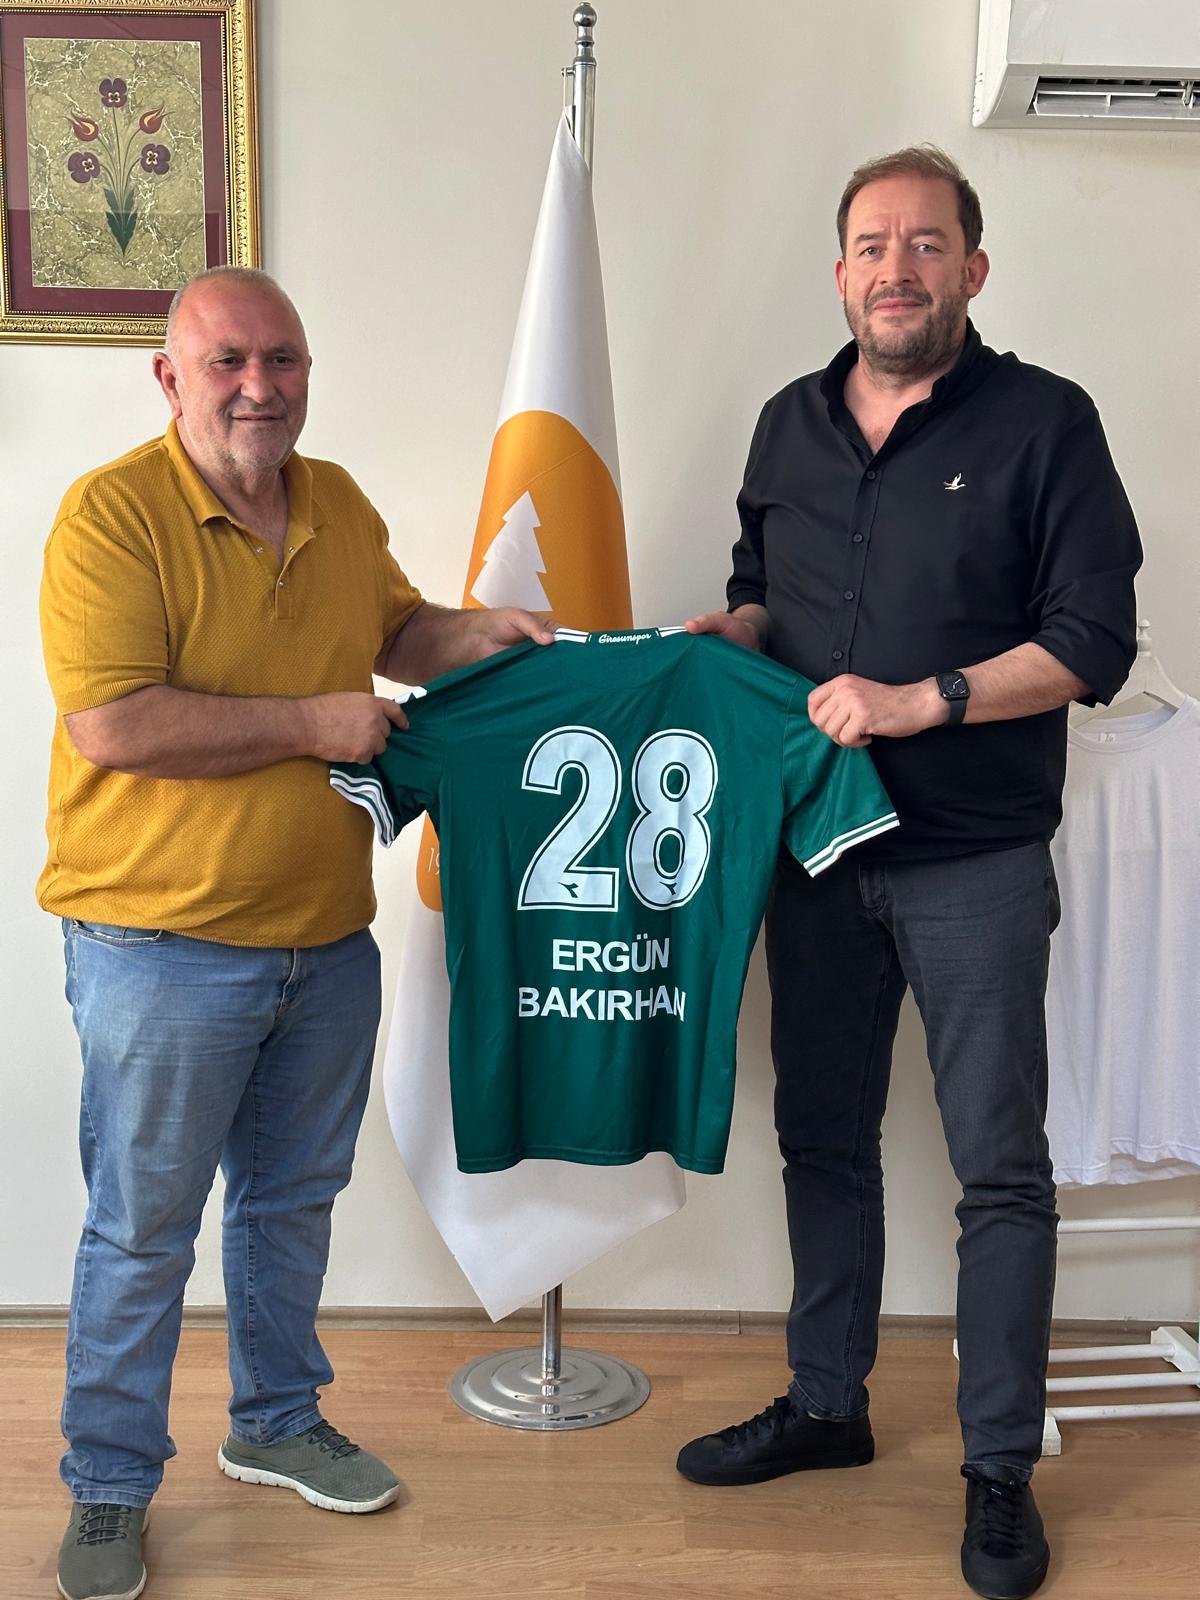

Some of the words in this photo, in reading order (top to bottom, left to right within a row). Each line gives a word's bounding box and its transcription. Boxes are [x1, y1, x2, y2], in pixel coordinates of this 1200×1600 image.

[598, 633, 652, 645] Giresunspor
[517, 725, 719, 913] 28
[552, 932, 670, 973] ERGÜN
[518, 985, 687, 1022] BAKIRHAN
